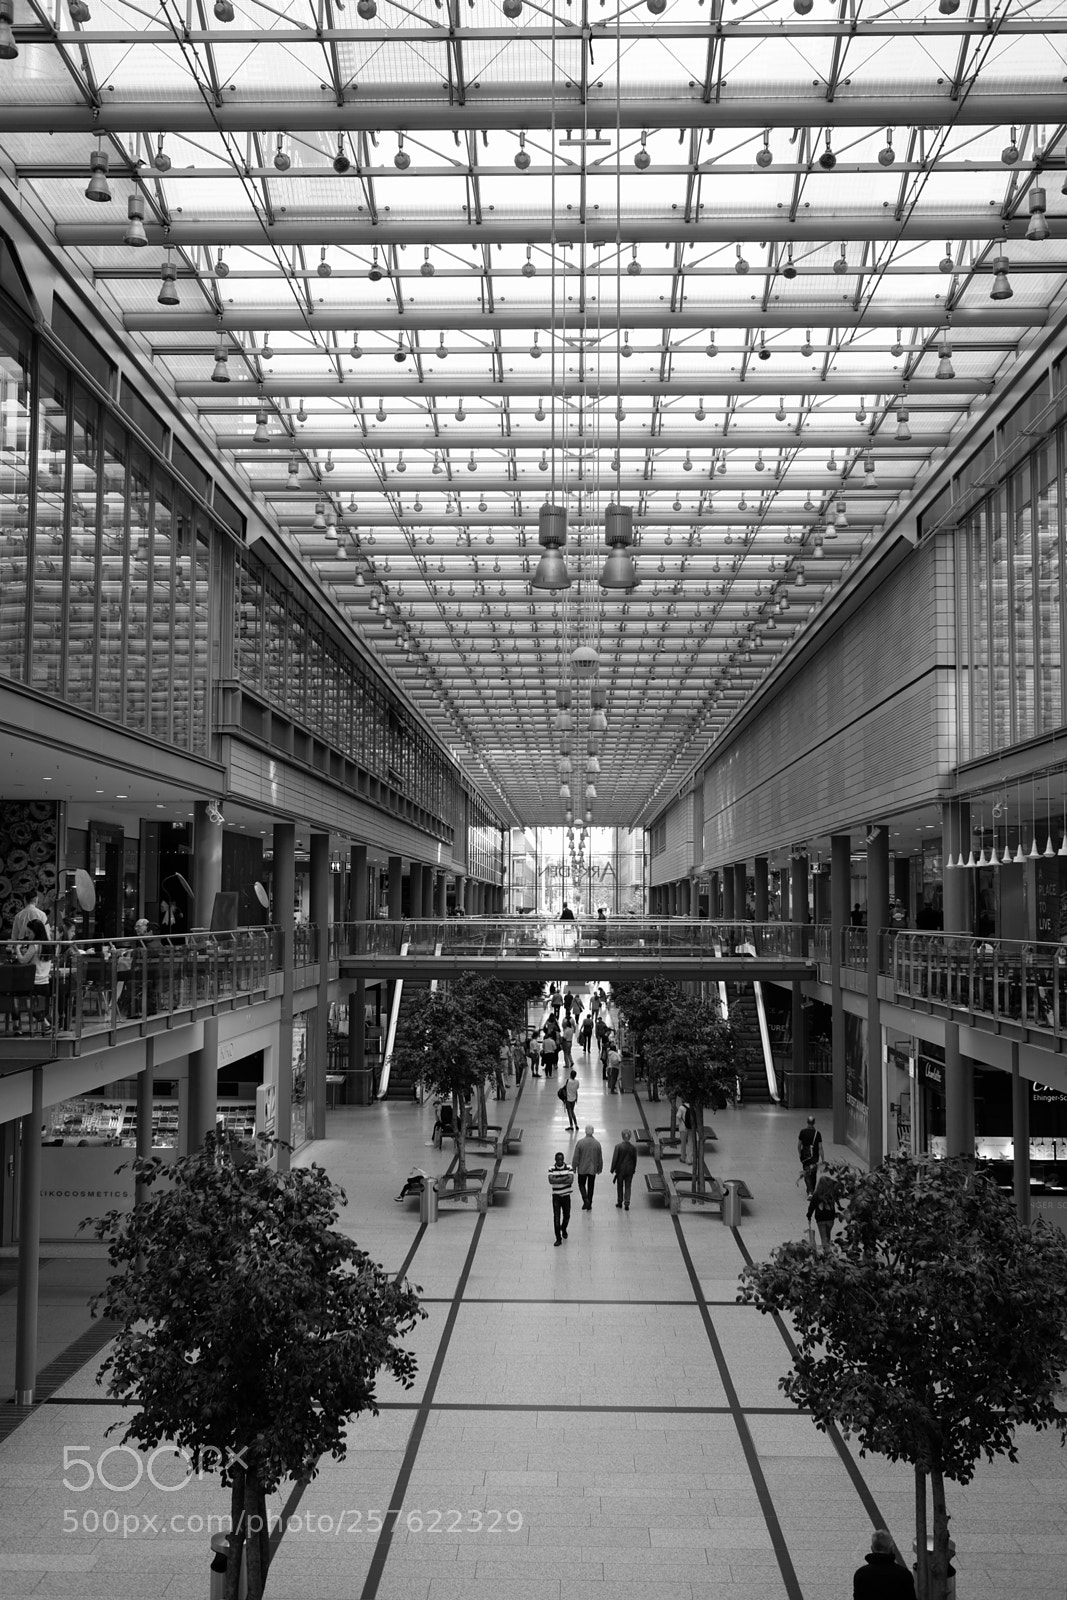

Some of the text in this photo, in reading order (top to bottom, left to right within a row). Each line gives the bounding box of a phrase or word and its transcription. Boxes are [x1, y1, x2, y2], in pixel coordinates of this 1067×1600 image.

[1038, 884, 1057, 897] PLACE
[1038, 901, 1047, 913] TO
[1038, 918, 1052, 930] LIVE
